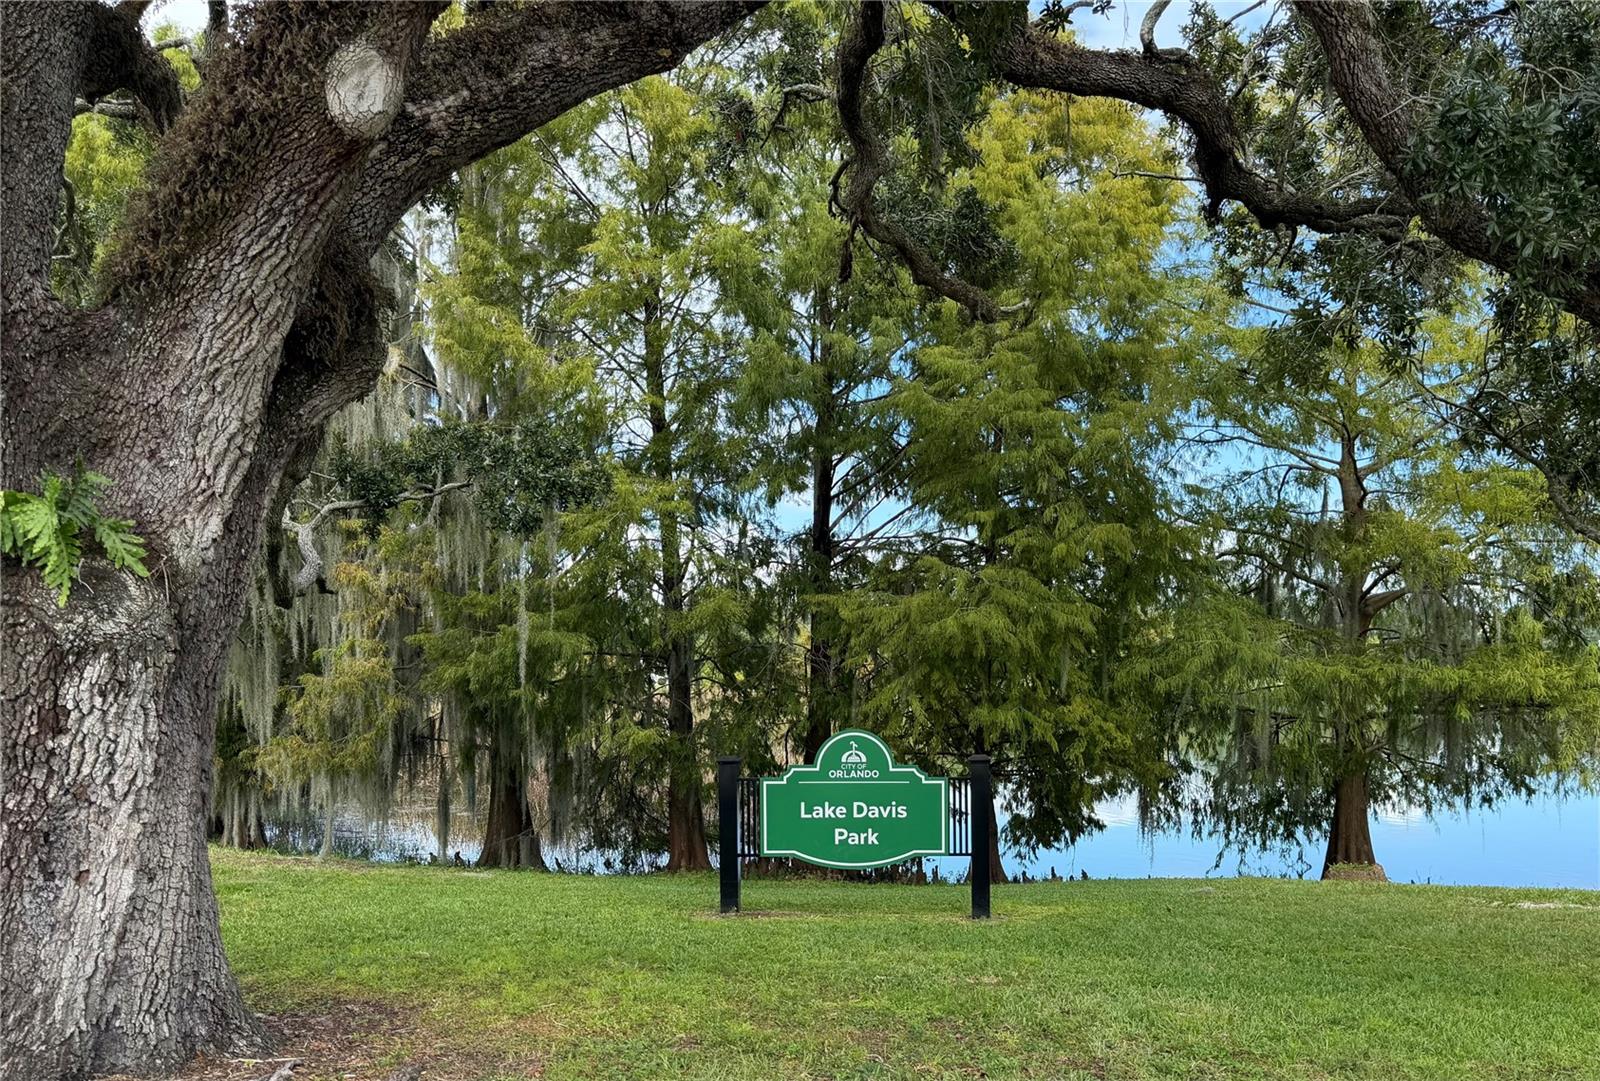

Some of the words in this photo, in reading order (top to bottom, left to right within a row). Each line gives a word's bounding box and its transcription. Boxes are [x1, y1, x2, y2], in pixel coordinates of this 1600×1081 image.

[829, 770, 879, 778] ORLANDO
[801, 802, 847, 818] Lake
[853, 801, 907, 818] Davis
[835, 828, 879, 845] Park
